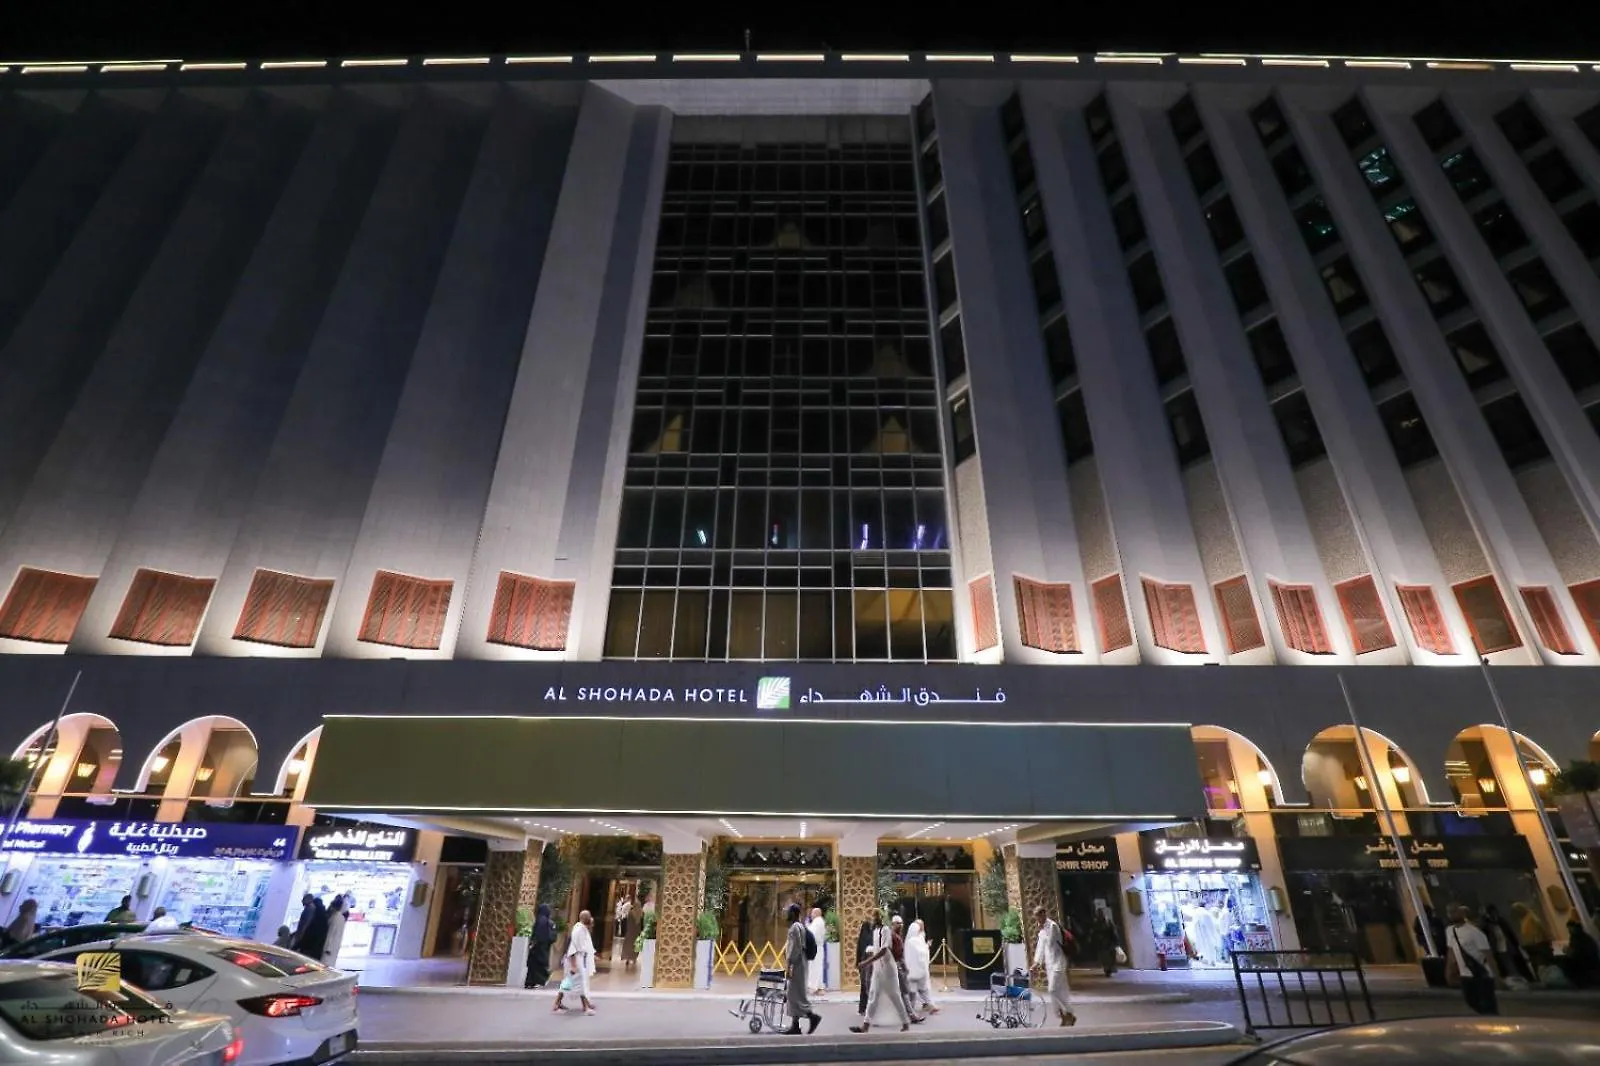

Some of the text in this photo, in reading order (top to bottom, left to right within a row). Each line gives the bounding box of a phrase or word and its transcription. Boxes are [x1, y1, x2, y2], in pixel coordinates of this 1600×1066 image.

[544, 686, 748, 703] AL SHOHADA HOTEL
[799, 685, 1007, 706] فندق الشهداء
[15, 821, 76, 838] Pharmacy
[108, 822, 207, 842] صيدلية غاية
[1076, 842, 1105, 856] محل
[1411, 839, 1444, 854] محل
[1055, 860, 1109, 870] SHIR SHOP
